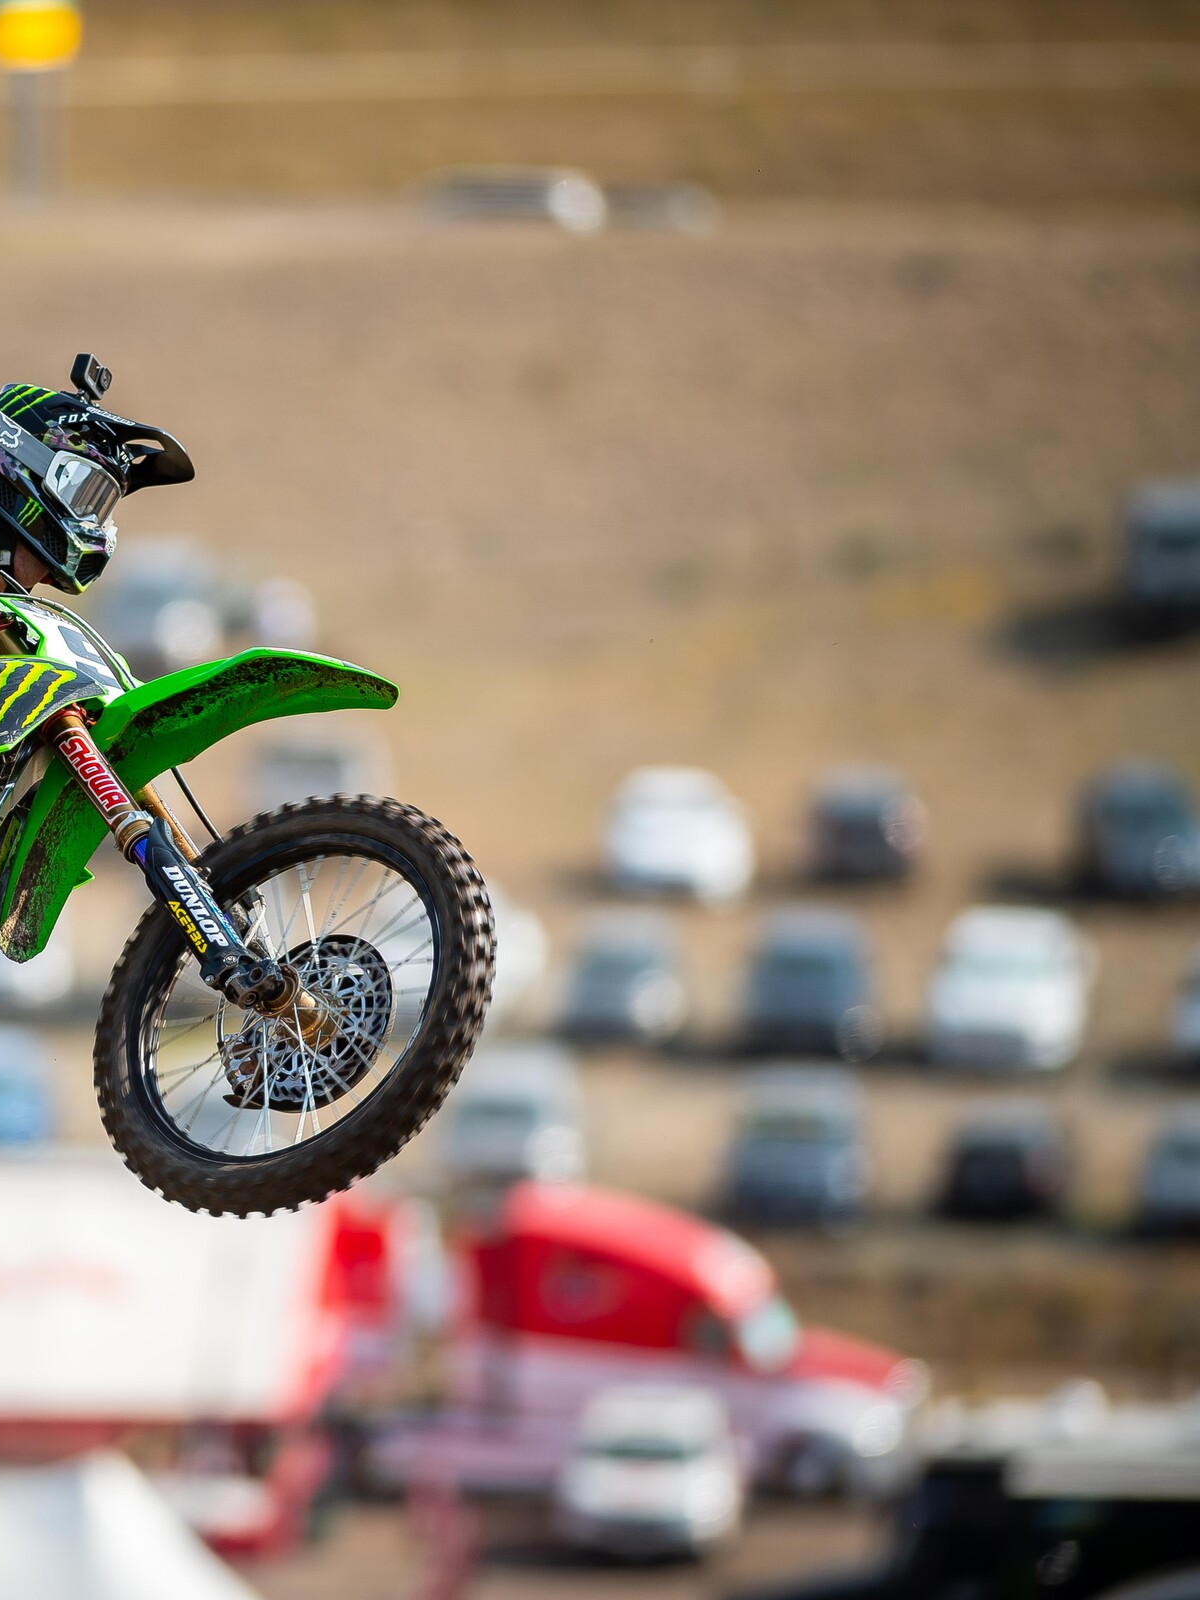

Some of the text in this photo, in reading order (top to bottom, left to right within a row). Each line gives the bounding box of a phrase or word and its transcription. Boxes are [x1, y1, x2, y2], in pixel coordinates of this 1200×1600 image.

[58, 412, 90, 425] FOX
[59, 736, 130, 812] SHOWA
[161, 865, 230, 947] DUNLOP
